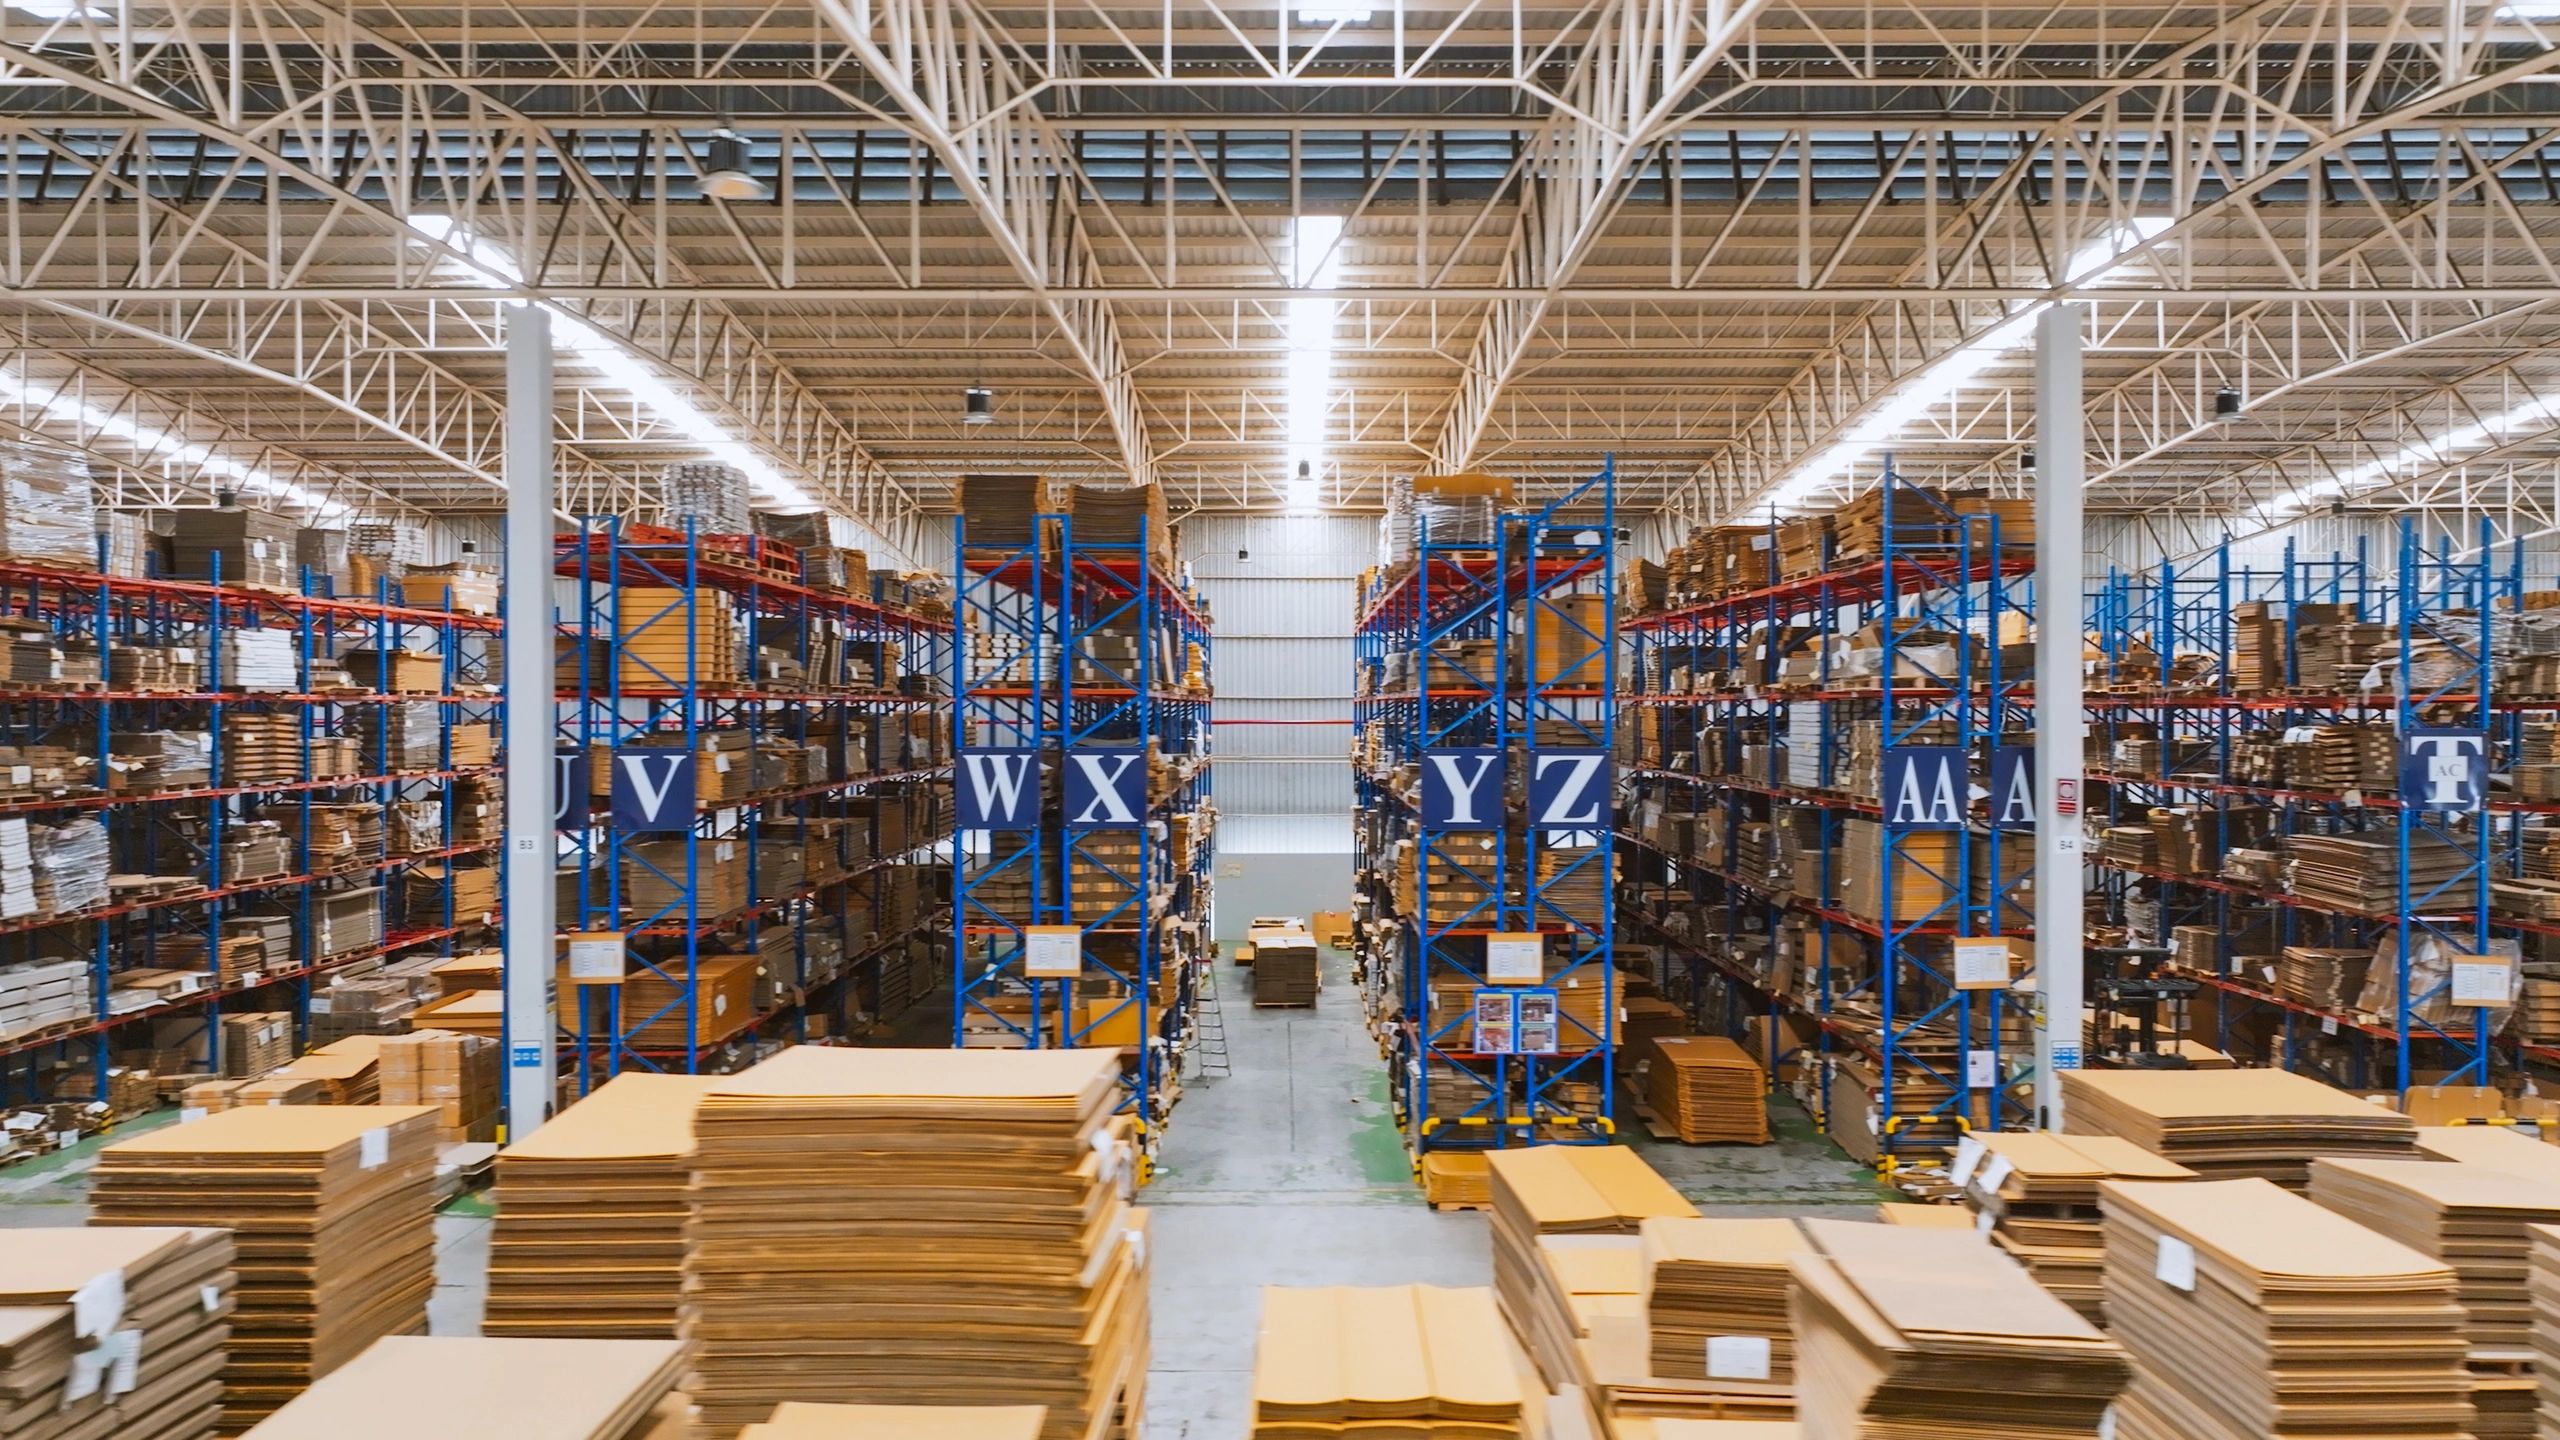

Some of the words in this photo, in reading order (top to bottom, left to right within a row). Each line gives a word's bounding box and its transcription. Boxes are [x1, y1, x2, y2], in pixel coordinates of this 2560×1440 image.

[617, 755, 687, 823] V
[962, 754, 1033, 822] W
[1071, 754, 1141, 823] X
[1427, 755, 1498, 823] Y
[1535, 755, 1605, 823] Z
[1892, 755, 1962, 823] AA
[2000, 755, 2036, 822] A
[2410, 735, 2483, 804] T
[2435, 763, 2463, 777] AC
